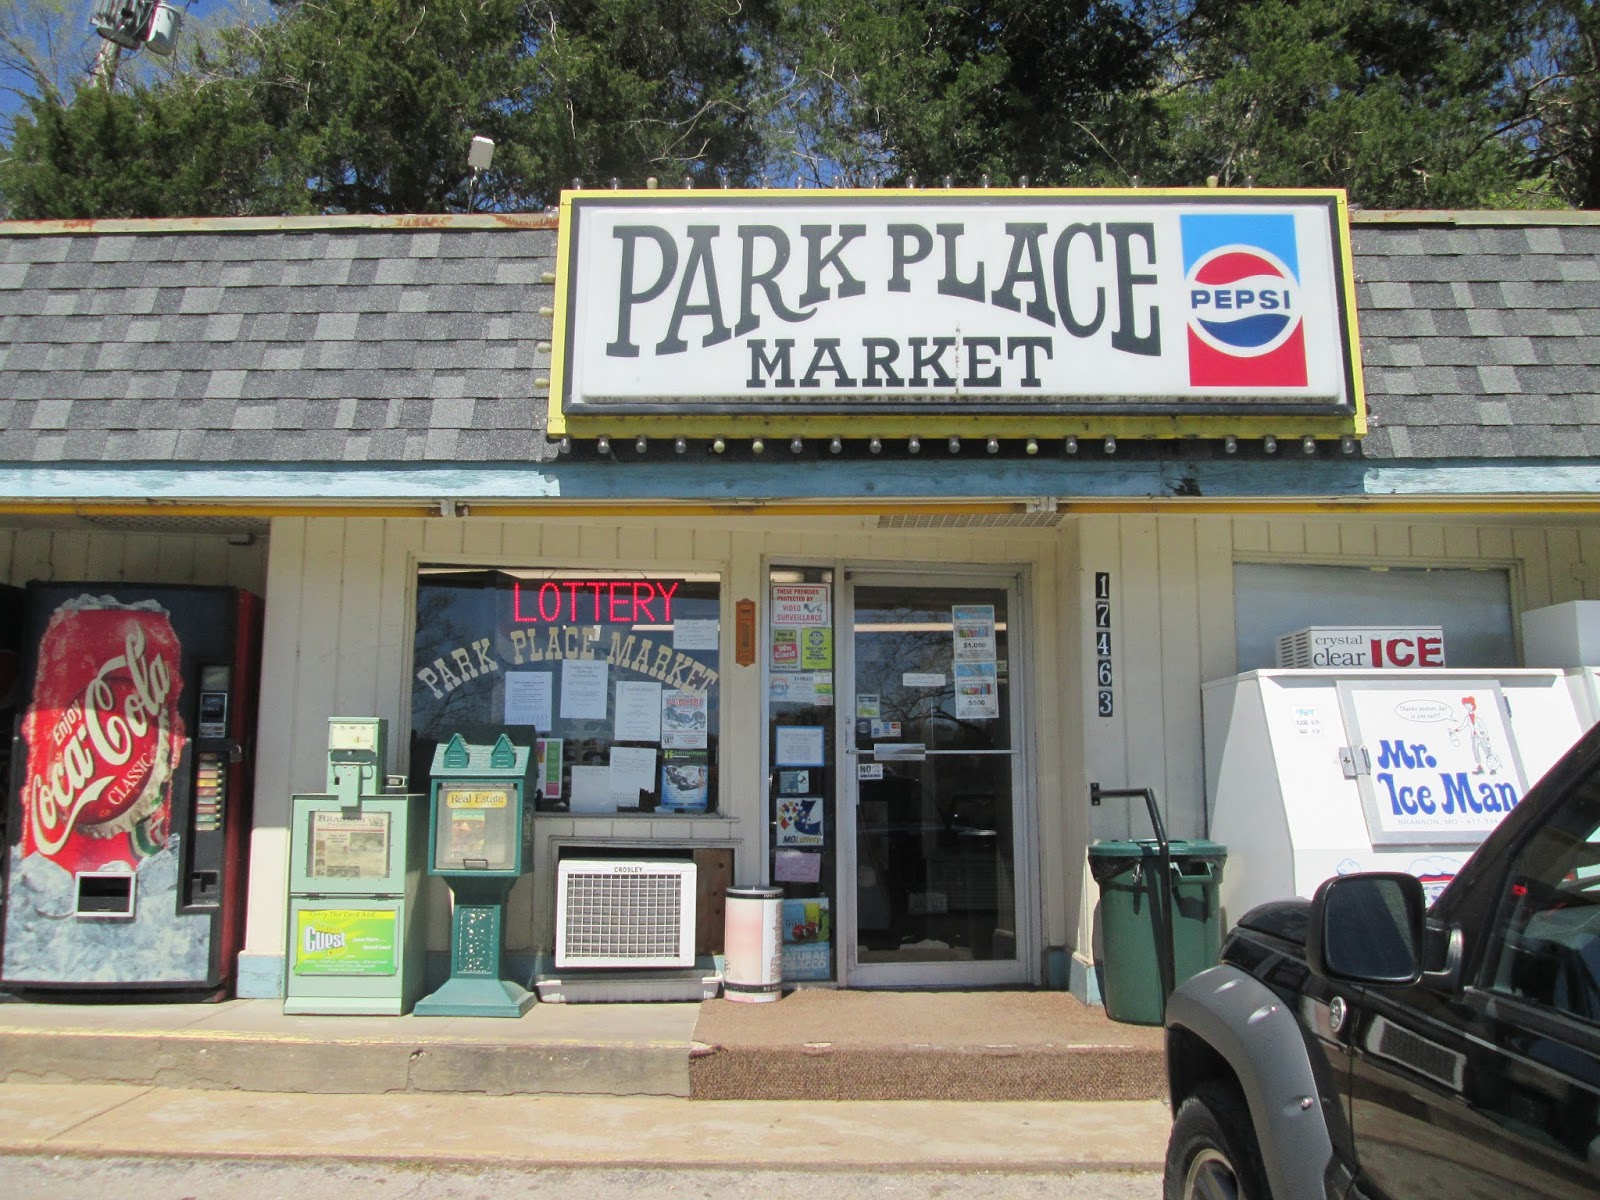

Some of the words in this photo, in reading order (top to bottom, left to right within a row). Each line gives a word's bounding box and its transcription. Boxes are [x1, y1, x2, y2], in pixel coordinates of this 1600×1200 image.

[606, 224, 866, 357] PARK
[887, 222, 1161, 356] PLACE
[1191, 289, 1291, 309] PEPSI
[746, 337, 1053, 388] MARKET
[513, 582, 679, 622] LOTTERY
[417, 637, 498, 699] PARK
[510, 627, 596, 665] PLACE
[606, 631, 719, 694] MARKET
[1097, 575, 1112, 714] 17463
[1313, 648, 1366, 666] clear
[1315, 635, 1363, 647] crystal
[1370, 636, 1443, 668] ICE
[32, 623, 170, 856] Coca-Cola
[53, 699, 84, 746] Enjoy
[1378, 740, 1437, 769] Mr.
[108, 752, 154, 806] CLASSIC
[451, 794, 471, 804] Real
[475, 794, 503, 803] Estate
[1377, 772, 1437, 815] Ice
[1438, 772, 1519, 814] Man
[782, 960, 827, 970] OBACCO
[783, 951, 826, 961] ATURAL
